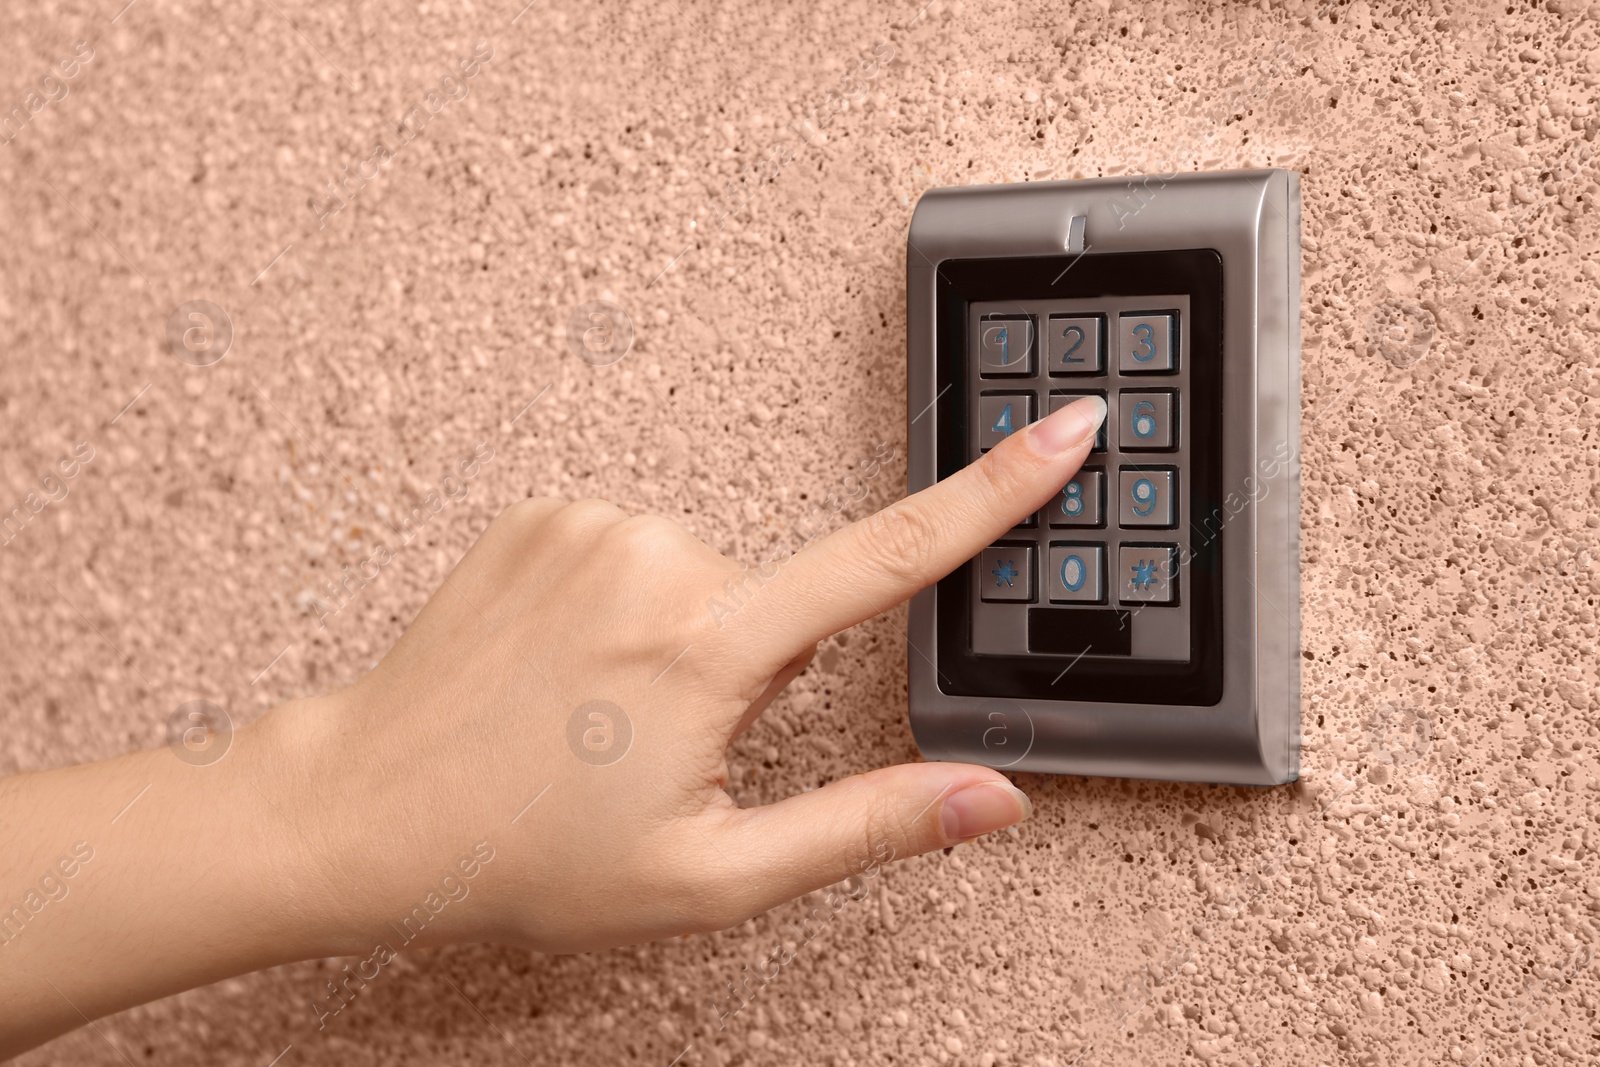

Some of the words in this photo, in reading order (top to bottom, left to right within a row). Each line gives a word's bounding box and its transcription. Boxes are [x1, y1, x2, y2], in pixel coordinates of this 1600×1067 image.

[993, 327, 1009, 366] 1
[1061, 325, 1086, 363] 2
[1130, 323, 1157, 363] 3
[992, 403, 1015, 438] 4
[1130, 401, 1156, 439] 6
[1061, 480, 1085, 518] 8
[1131, 478, 1157, 517] 9
[1060, 554, 1087, 592] 0
[1130, 558, 1158, 591] #
